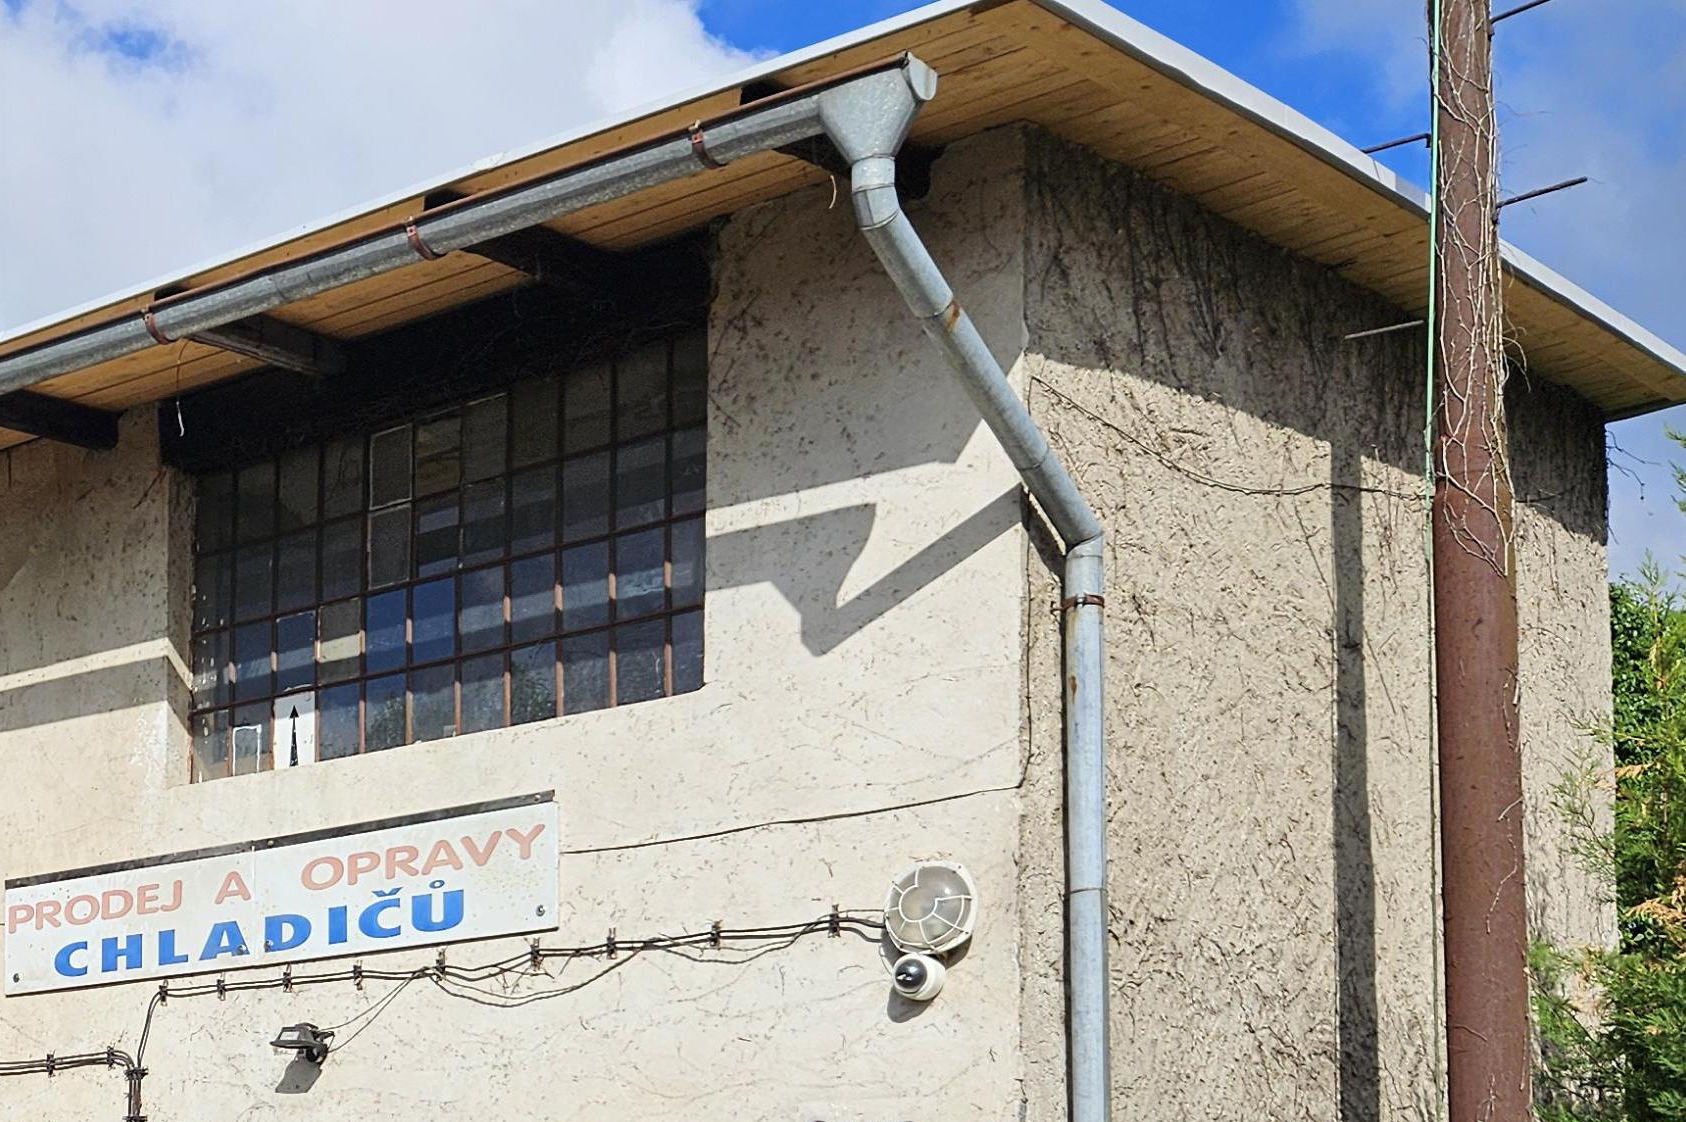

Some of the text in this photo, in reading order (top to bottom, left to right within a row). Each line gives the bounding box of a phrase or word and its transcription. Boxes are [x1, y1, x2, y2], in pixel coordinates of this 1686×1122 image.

[8, 824, 546, 934] PRODEJ A OPRAVY
[53, 879, 466, 977] CHLADIČŮ
